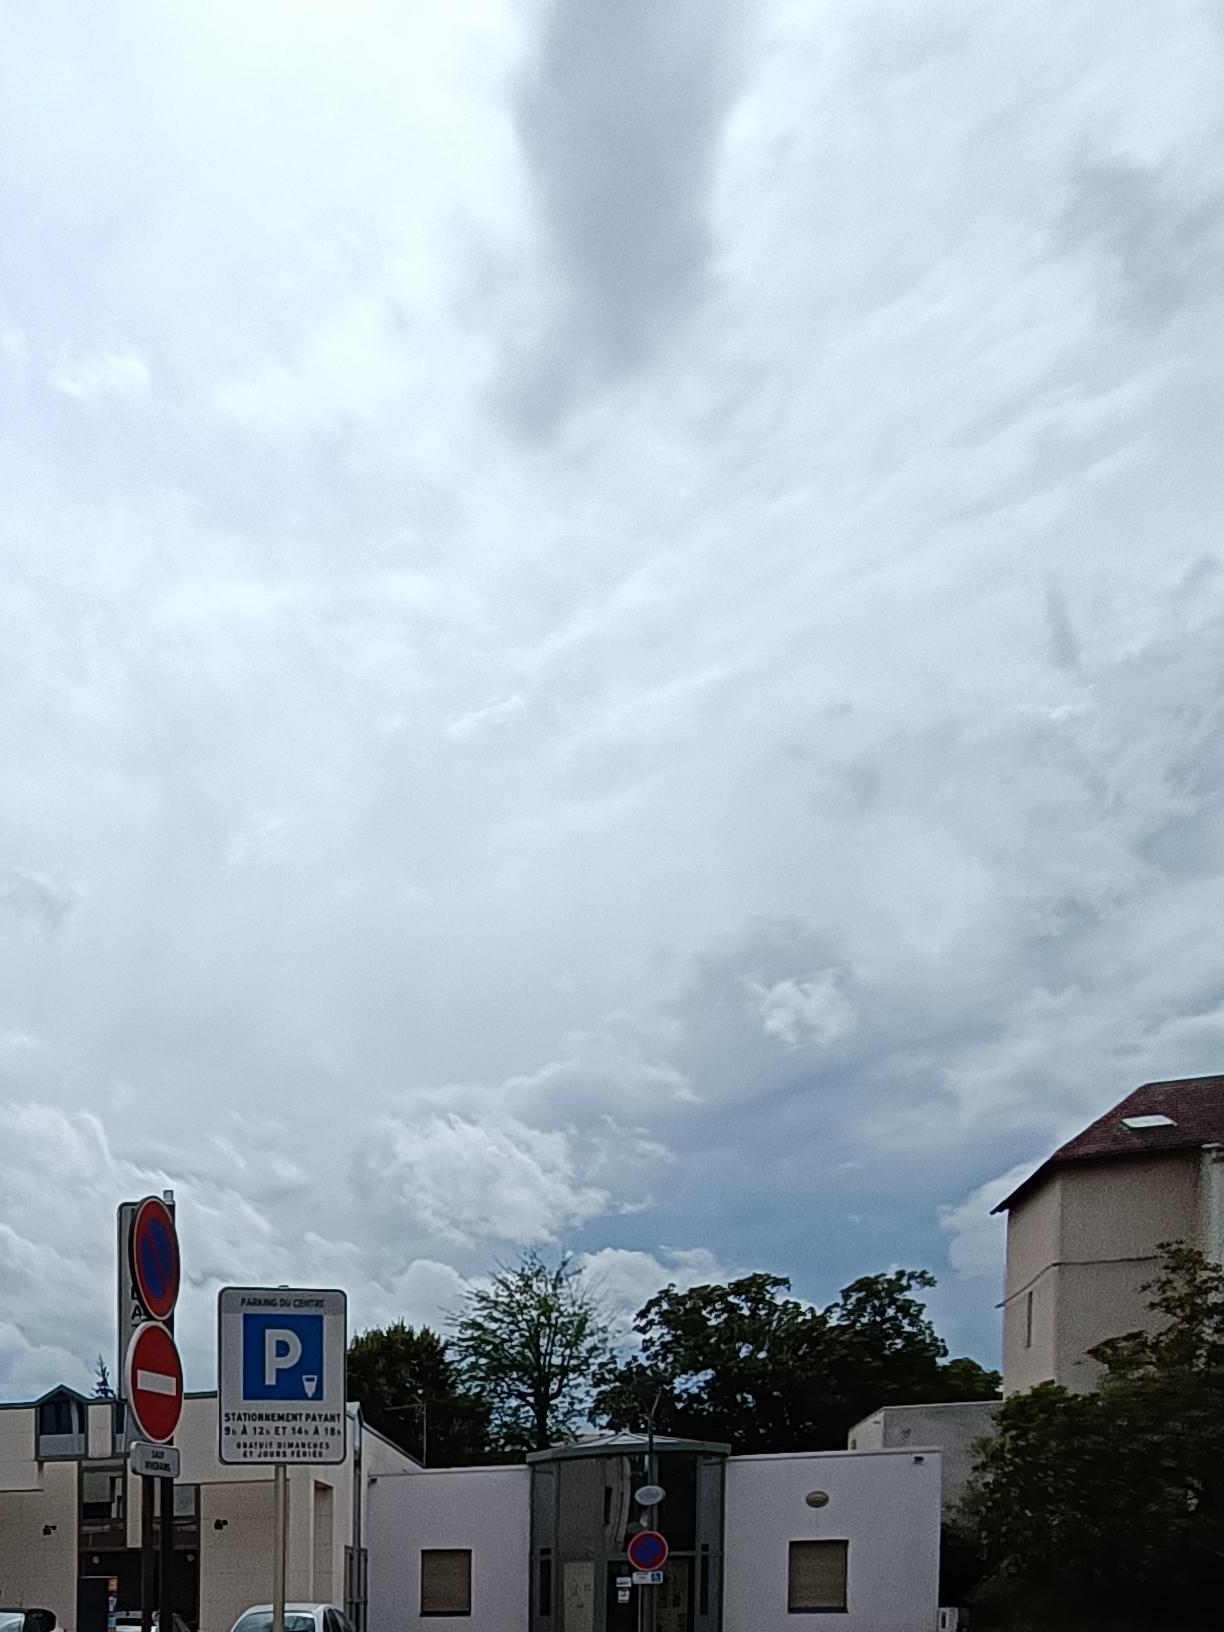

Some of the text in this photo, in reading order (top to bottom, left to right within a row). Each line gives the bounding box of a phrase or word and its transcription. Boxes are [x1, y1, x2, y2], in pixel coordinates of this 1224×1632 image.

[240, 1297, 325, 1308] PARKING DU CENTRE
[265, 1329, 302, 1385] P
[224, 1413, 341, 1422] STATIONNEMENT PAYANT
[240, 1424, 247, 1436] À
[274, 1426, 287, 1435] ET
[312, 1425, 320, 1436] À
[236, 1441, 330, 1450] GRATUIT DIMANCHES
[242, 1450, 253, 1458] ET
[257, 1450, 287, 1458] JOURS
